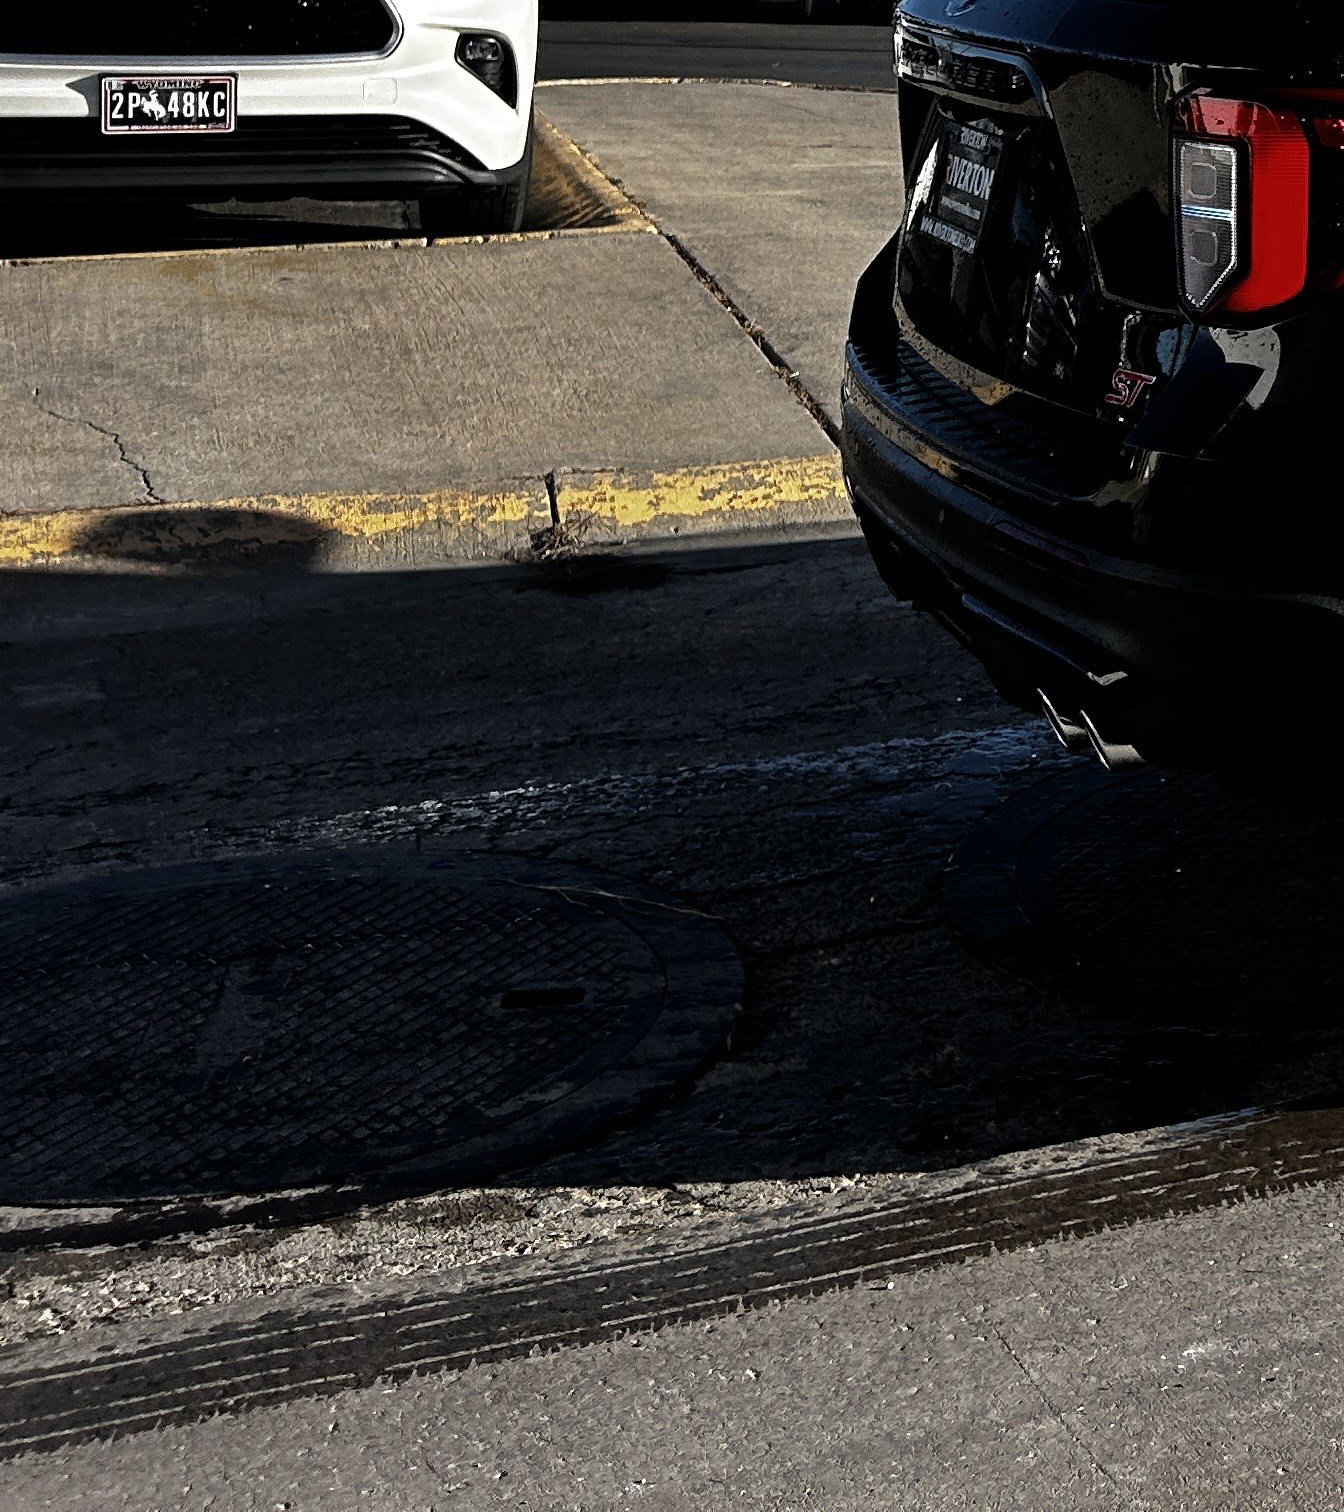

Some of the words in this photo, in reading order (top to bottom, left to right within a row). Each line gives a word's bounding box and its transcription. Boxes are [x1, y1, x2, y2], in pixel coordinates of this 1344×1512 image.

[111, 91, 141, 119] 2P
[167, 91, 226, 118] 48KC
[1104, 368, 1156, 408] ST
